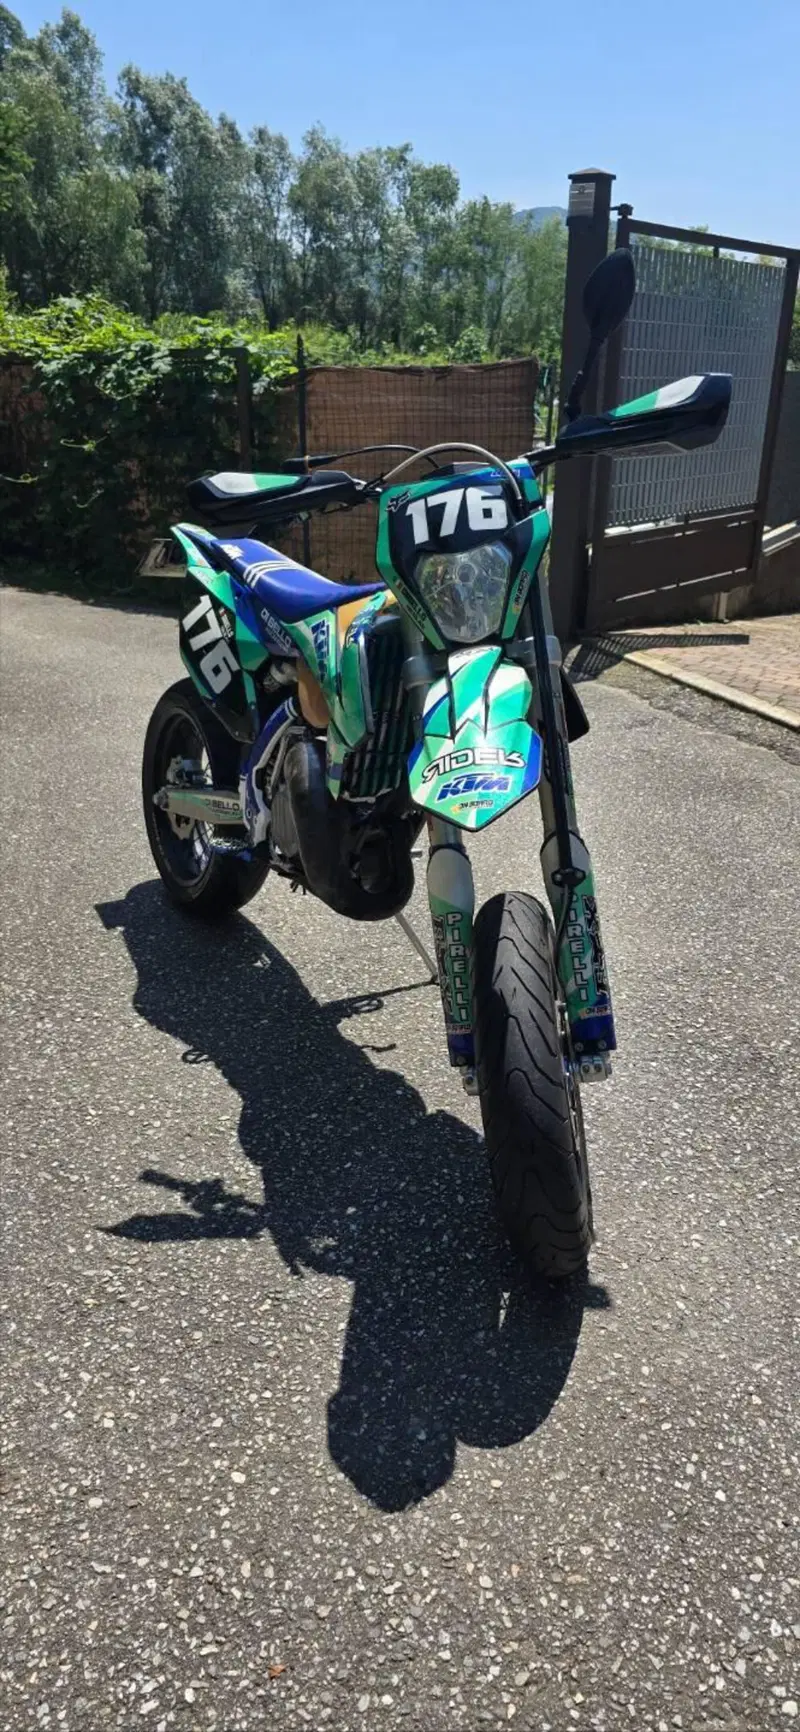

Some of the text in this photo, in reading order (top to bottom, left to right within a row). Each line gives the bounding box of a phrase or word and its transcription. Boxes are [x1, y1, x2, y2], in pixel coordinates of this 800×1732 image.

[405, 485, 508, 545] 176
[182, 594, 240, 694] 176
[267, 614, 293, 648] BELLO
[212, 799, 240, 811] BELLO
[436, 772, 511, 802] KTM
[446, 911, 472, 1024] PIRELLI
